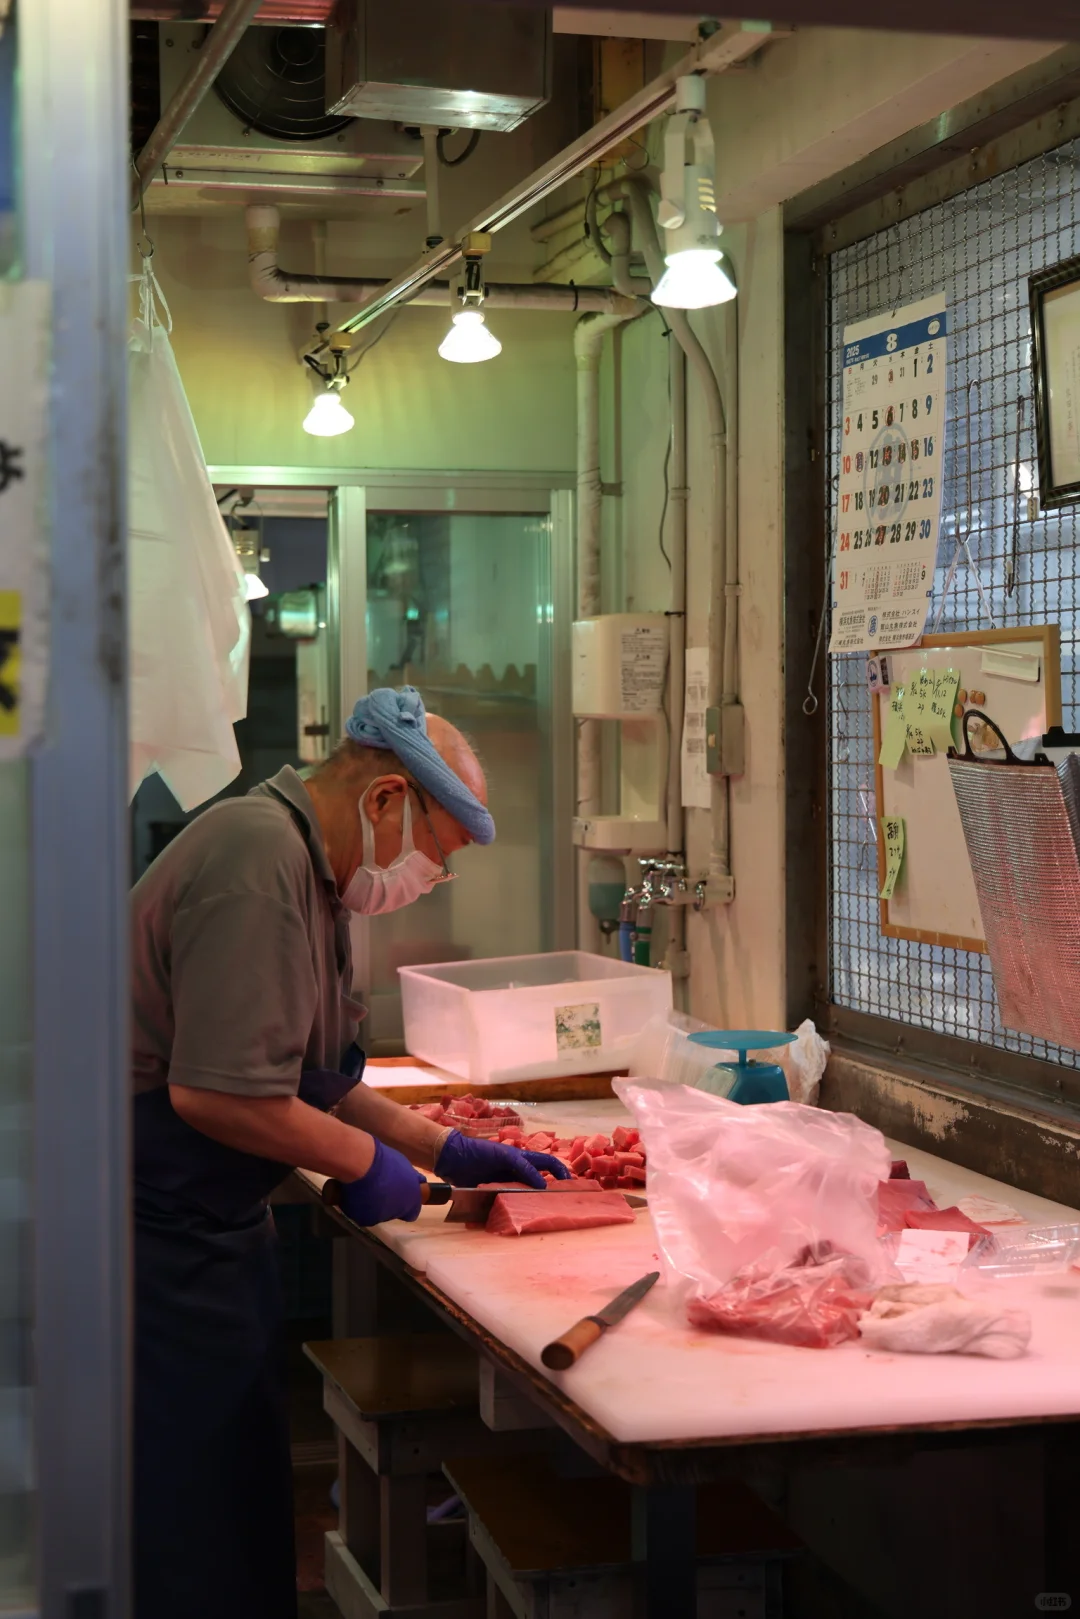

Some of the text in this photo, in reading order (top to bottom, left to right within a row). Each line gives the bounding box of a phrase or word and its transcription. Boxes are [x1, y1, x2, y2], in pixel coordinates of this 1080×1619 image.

[846, 345, 859, 358] 2025
[886, 333, 897, 352] 8
[860, 362, 865, 371] 月
[900, 367, 904, 377] 31
[914, 358, 918, 378] 1
[926, 354, 934, 374] 2
[845, 416, 850, 436] 3
[857, 414, 862, 432] 4
[872, 410, 878, 430] 5
[900, 403, 904, 422] 7
[912, 399, 918, 419] 8
[926, 394, 932, 415] 9
[843, 455, 850, 474] 10
[870, 450, 878, 468] 12
[924, 436, 933, 456] 16
[842, 478, 933, 512] 17 18 19 20 21 22 23
[840, 519, 930, 552] 24 25 26 27 28 29 30
[840, 571, 848, 590] 31
[921, 570, 926, 580] 9
